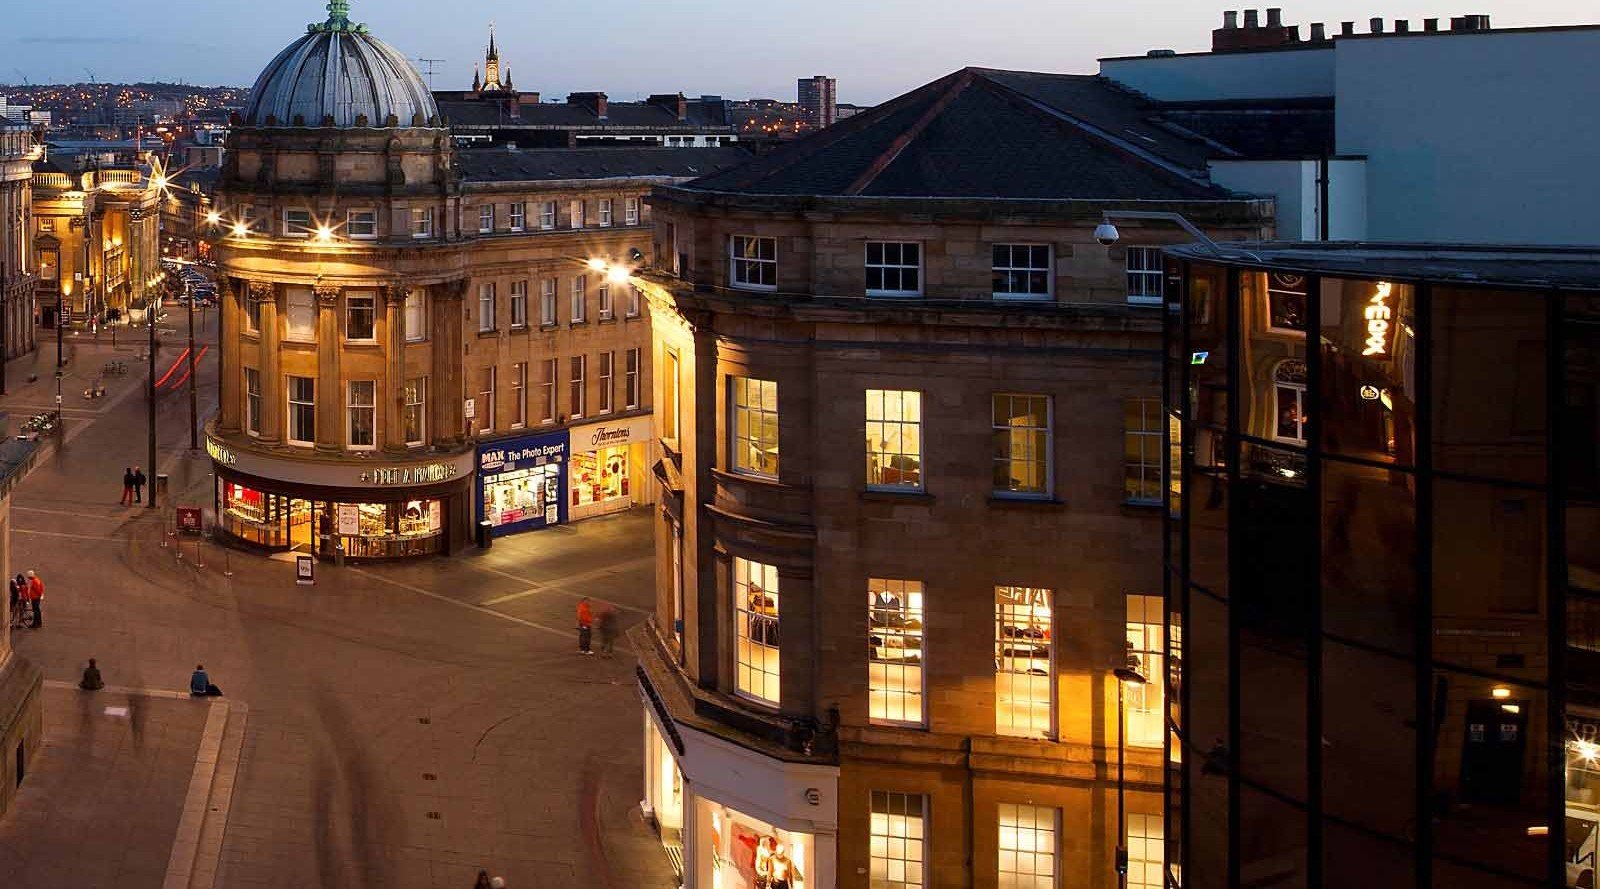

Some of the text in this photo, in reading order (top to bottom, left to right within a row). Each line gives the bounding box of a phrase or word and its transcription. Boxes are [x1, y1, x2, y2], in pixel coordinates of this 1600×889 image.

[592, 427, 629, 445] Thorntons
[481, 450, 504, 464] MAX
[508, 442, 564, 461] The Photo Expert
